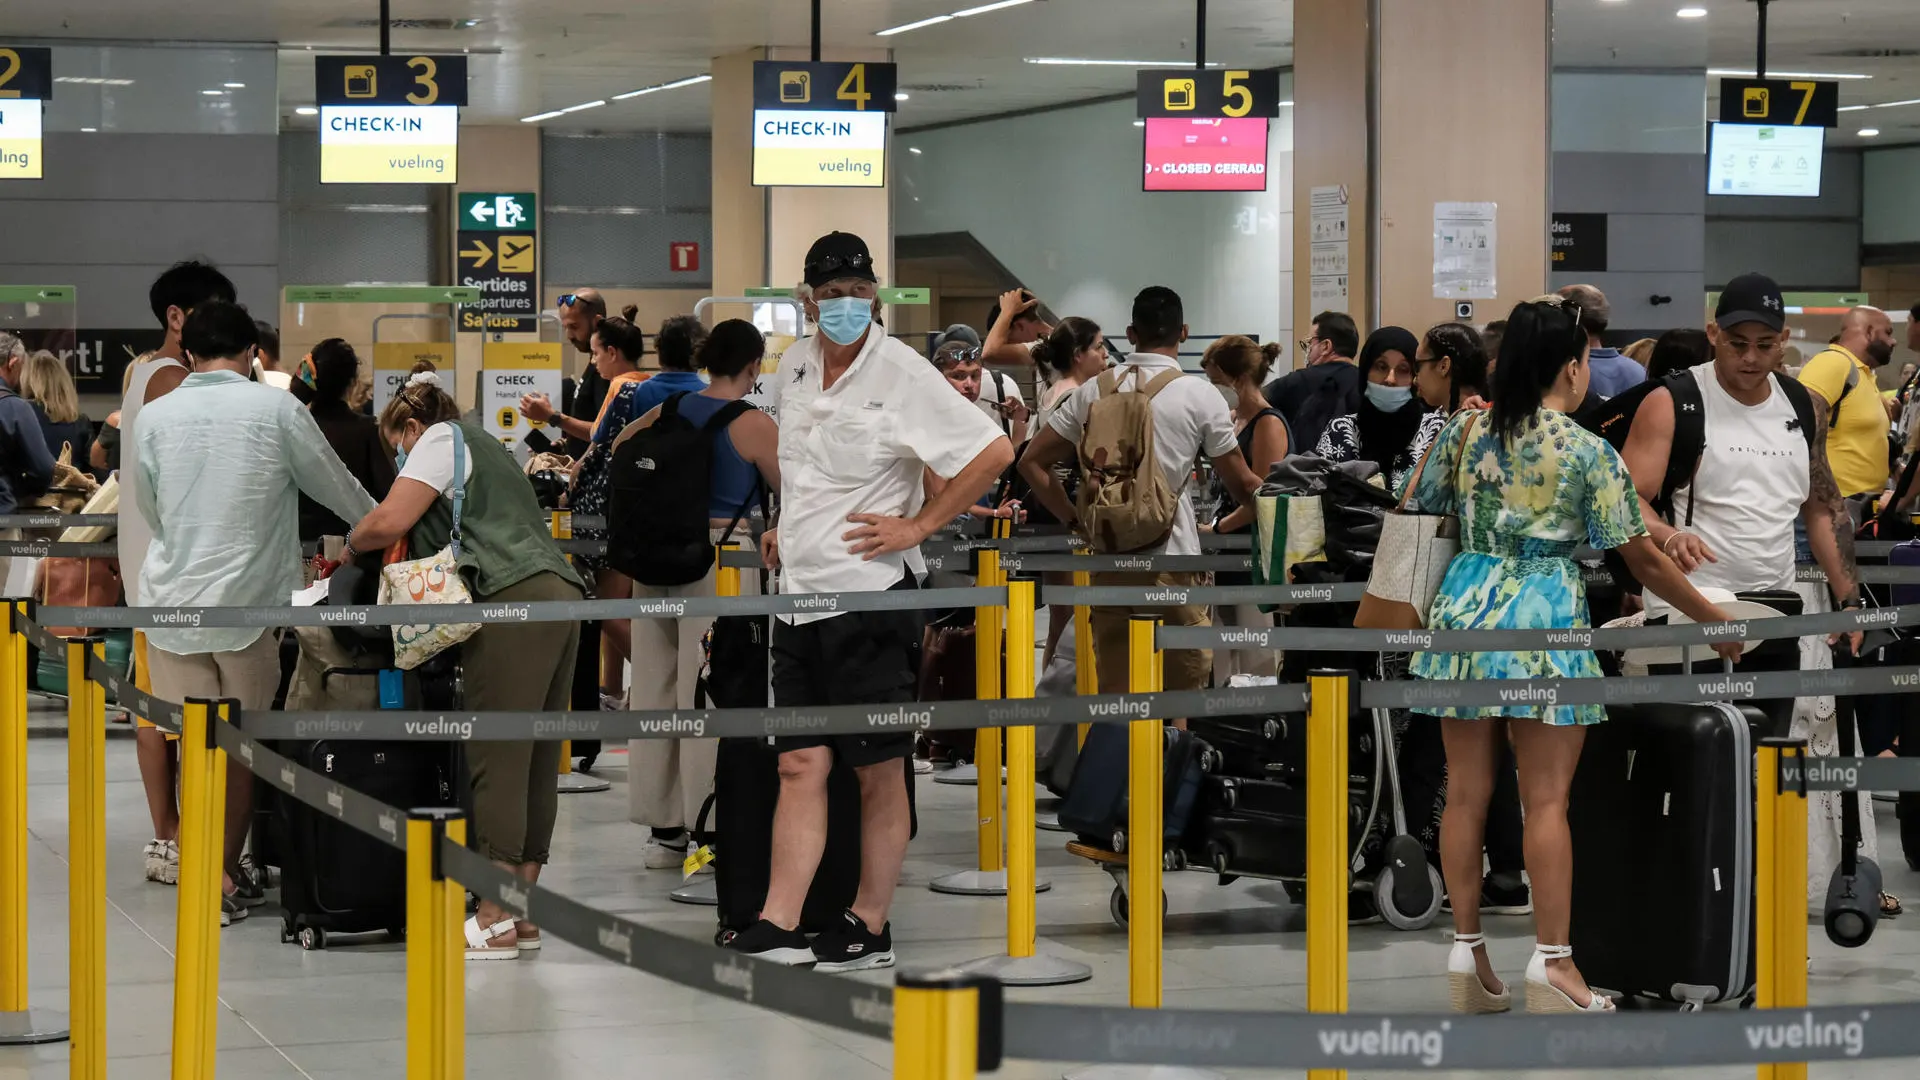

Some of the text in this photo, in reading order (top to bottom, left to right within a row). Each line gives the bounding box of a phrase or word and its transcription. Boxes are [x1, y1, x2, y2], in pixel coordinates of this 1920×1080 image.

[0, 48, 21, 98] 2
[406, 56, 438, 105] 3
[836, 63, 871, 110] 4
[1221, 71, 1253, 117] 5
[1790, 81, 1816, 126] 7
[331, 117, 422, 131] CHECK-IN
[764, 121, 851, 136] CHECK-IN
[0, 148, 28, 168] ling
[389, 154, 444, 173] vueling
[819, 158, 872, 176] vueling
[1162, 163, 1212, 174] CLOSED
[463, 277, 527, 292] Sortides
[59, 340, 103, 373] rt!
[495, 375, 535, 385] CHECK
[29, 516, 60, 526] vueling
[11, 544, 48, 556] vueling
[1114, 557, 1152, 570] vueling
[1145, 586, 1332, 604] vueling vueling
[152, 594, 838, 626] vueling vueling vueling vueling vueling
[1221, 609, 1898, 648] vueling vueling vueling vueling vueling
[1500, 683, 1557, 705] vueling
[1699, 676, 1754, 697] vueling
[405, 716, 473, 739] vueling
[640, 713, 705, 737] vueling
[867, 705, 931, 729] vueling
[1089, 696, 1150, 717] vueling
[1318, 1011, 1866, 1067] vueling vueling
